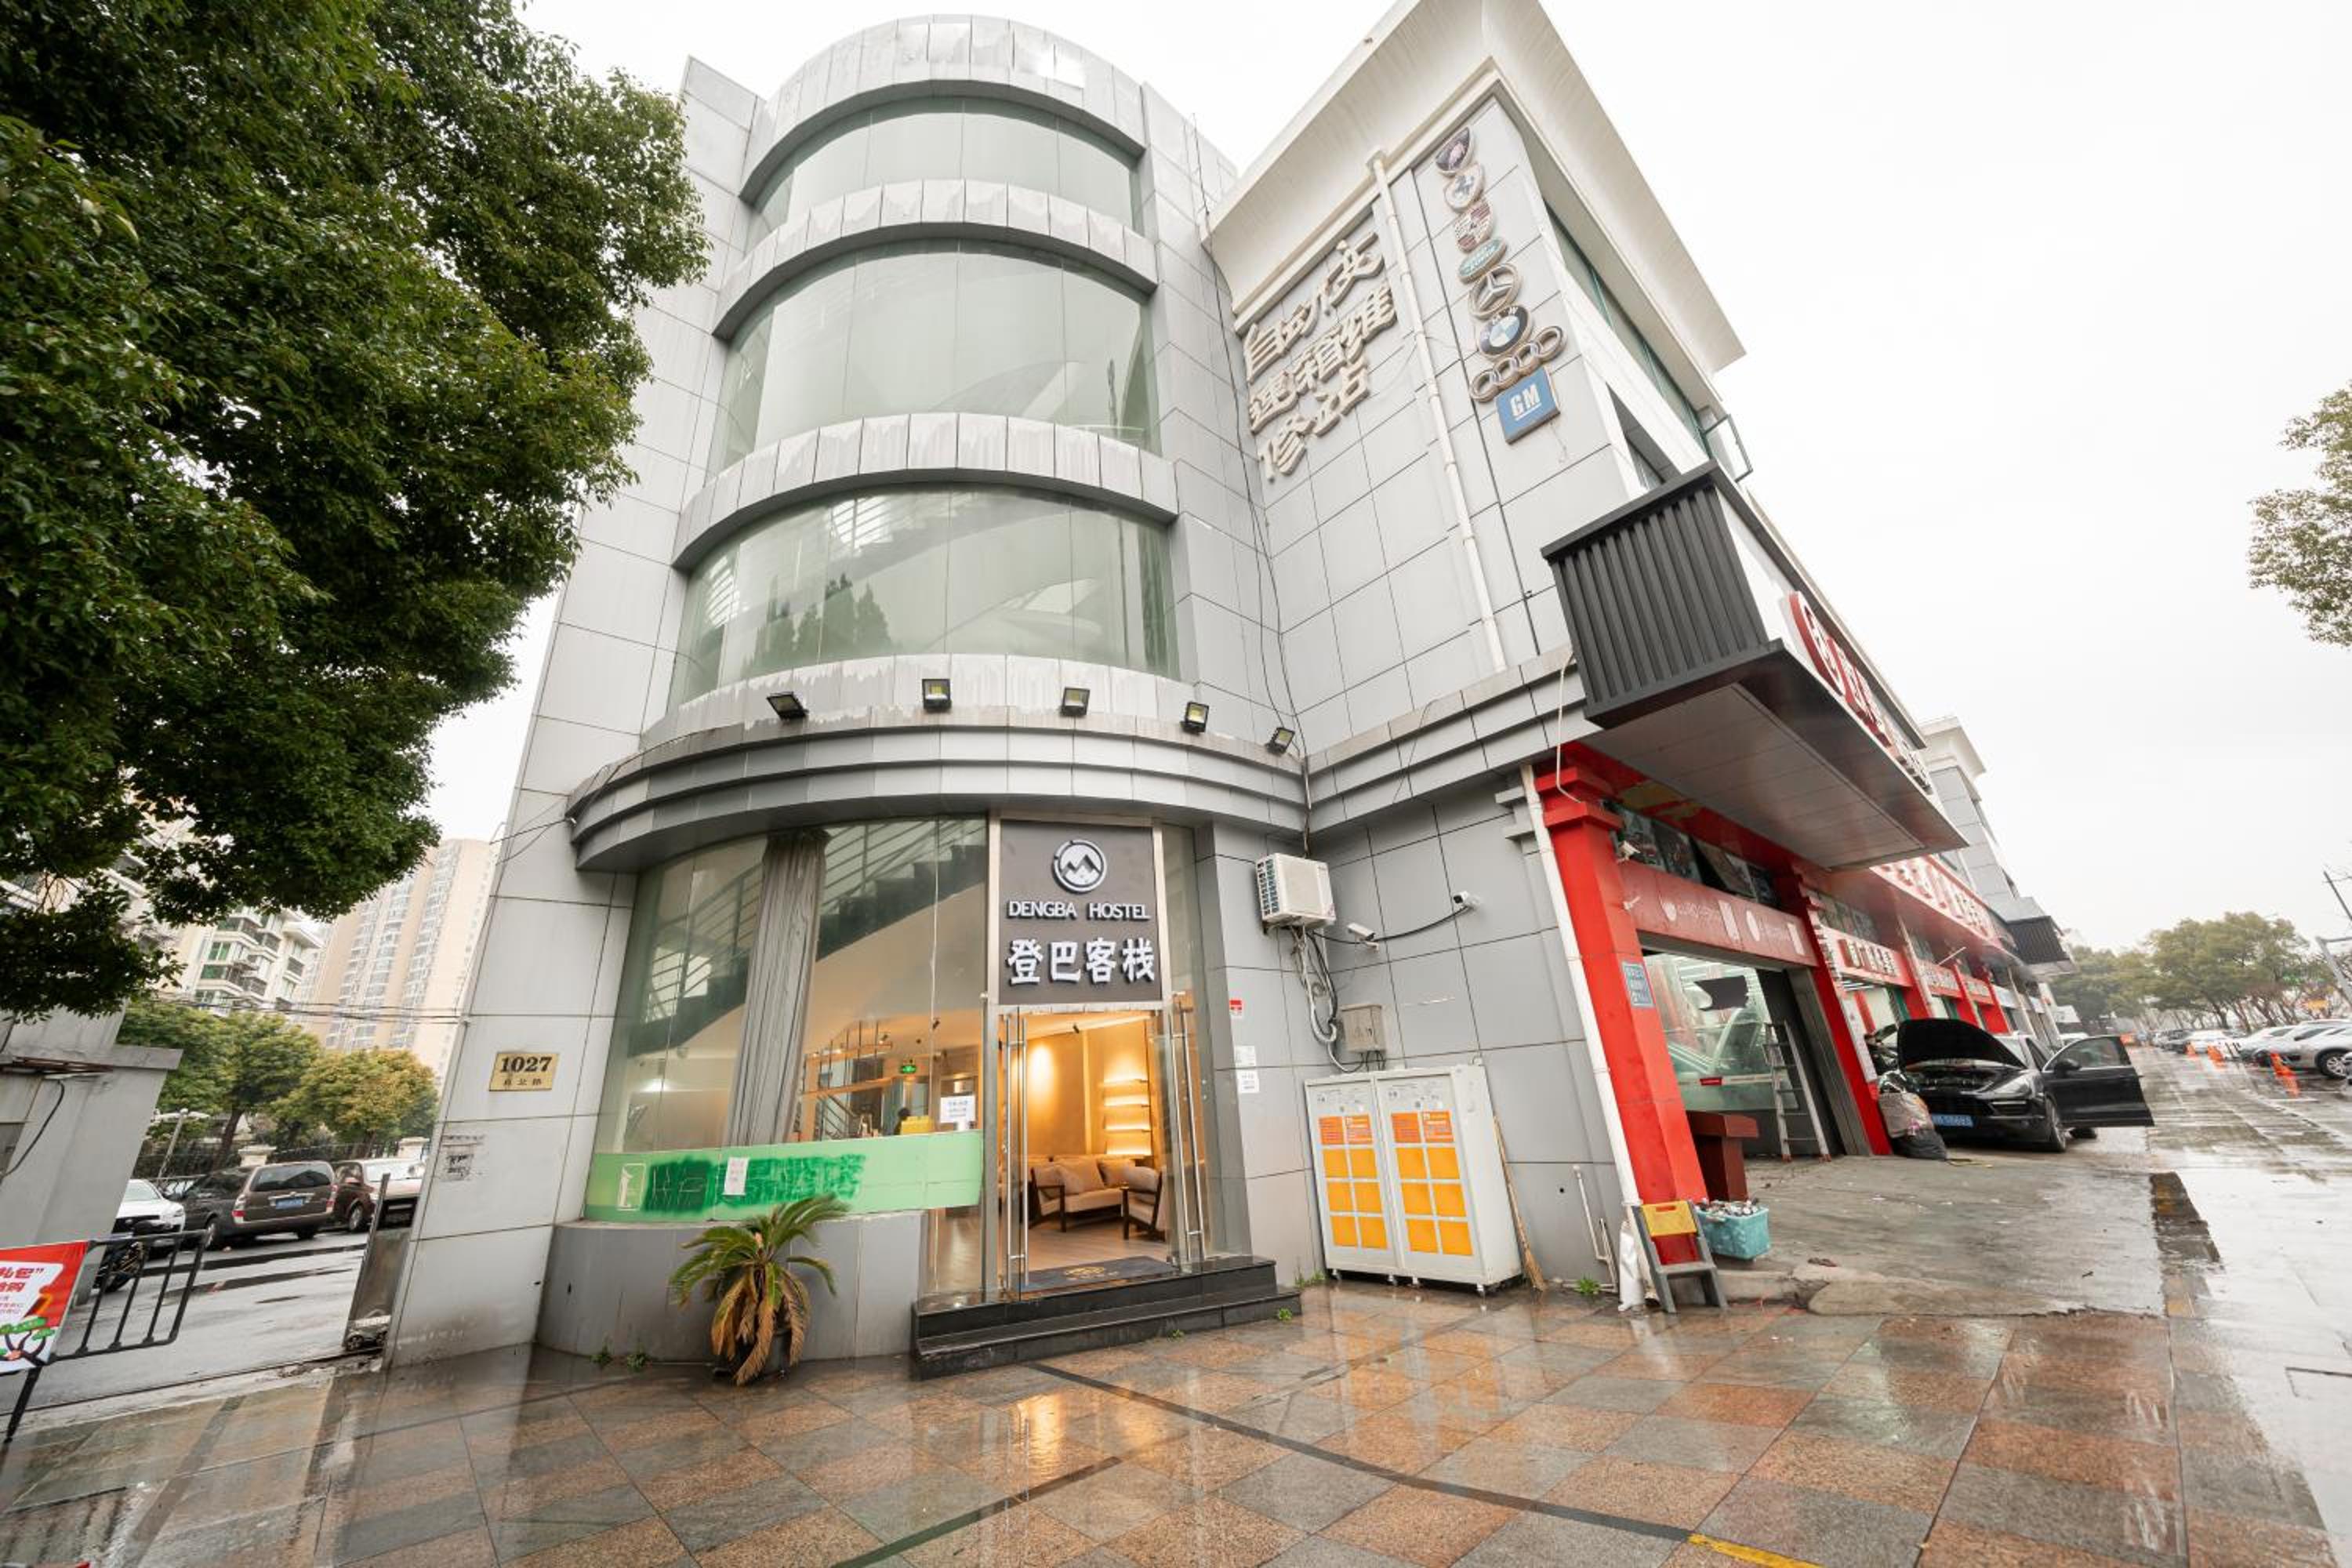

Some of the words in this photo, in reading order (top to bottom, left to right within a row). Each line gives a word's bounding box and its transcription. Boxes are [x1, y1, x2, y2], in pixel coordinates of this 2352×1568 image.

[1510, 384, 1541, 418] GM
[1007, 900, 1077, 919] DENGBA
[1088, 902, 1151, 920] HOSTEL
[1007, 938, 1156, 985] 登巴客栈
[500, 1056, 553, 1073] 1027
